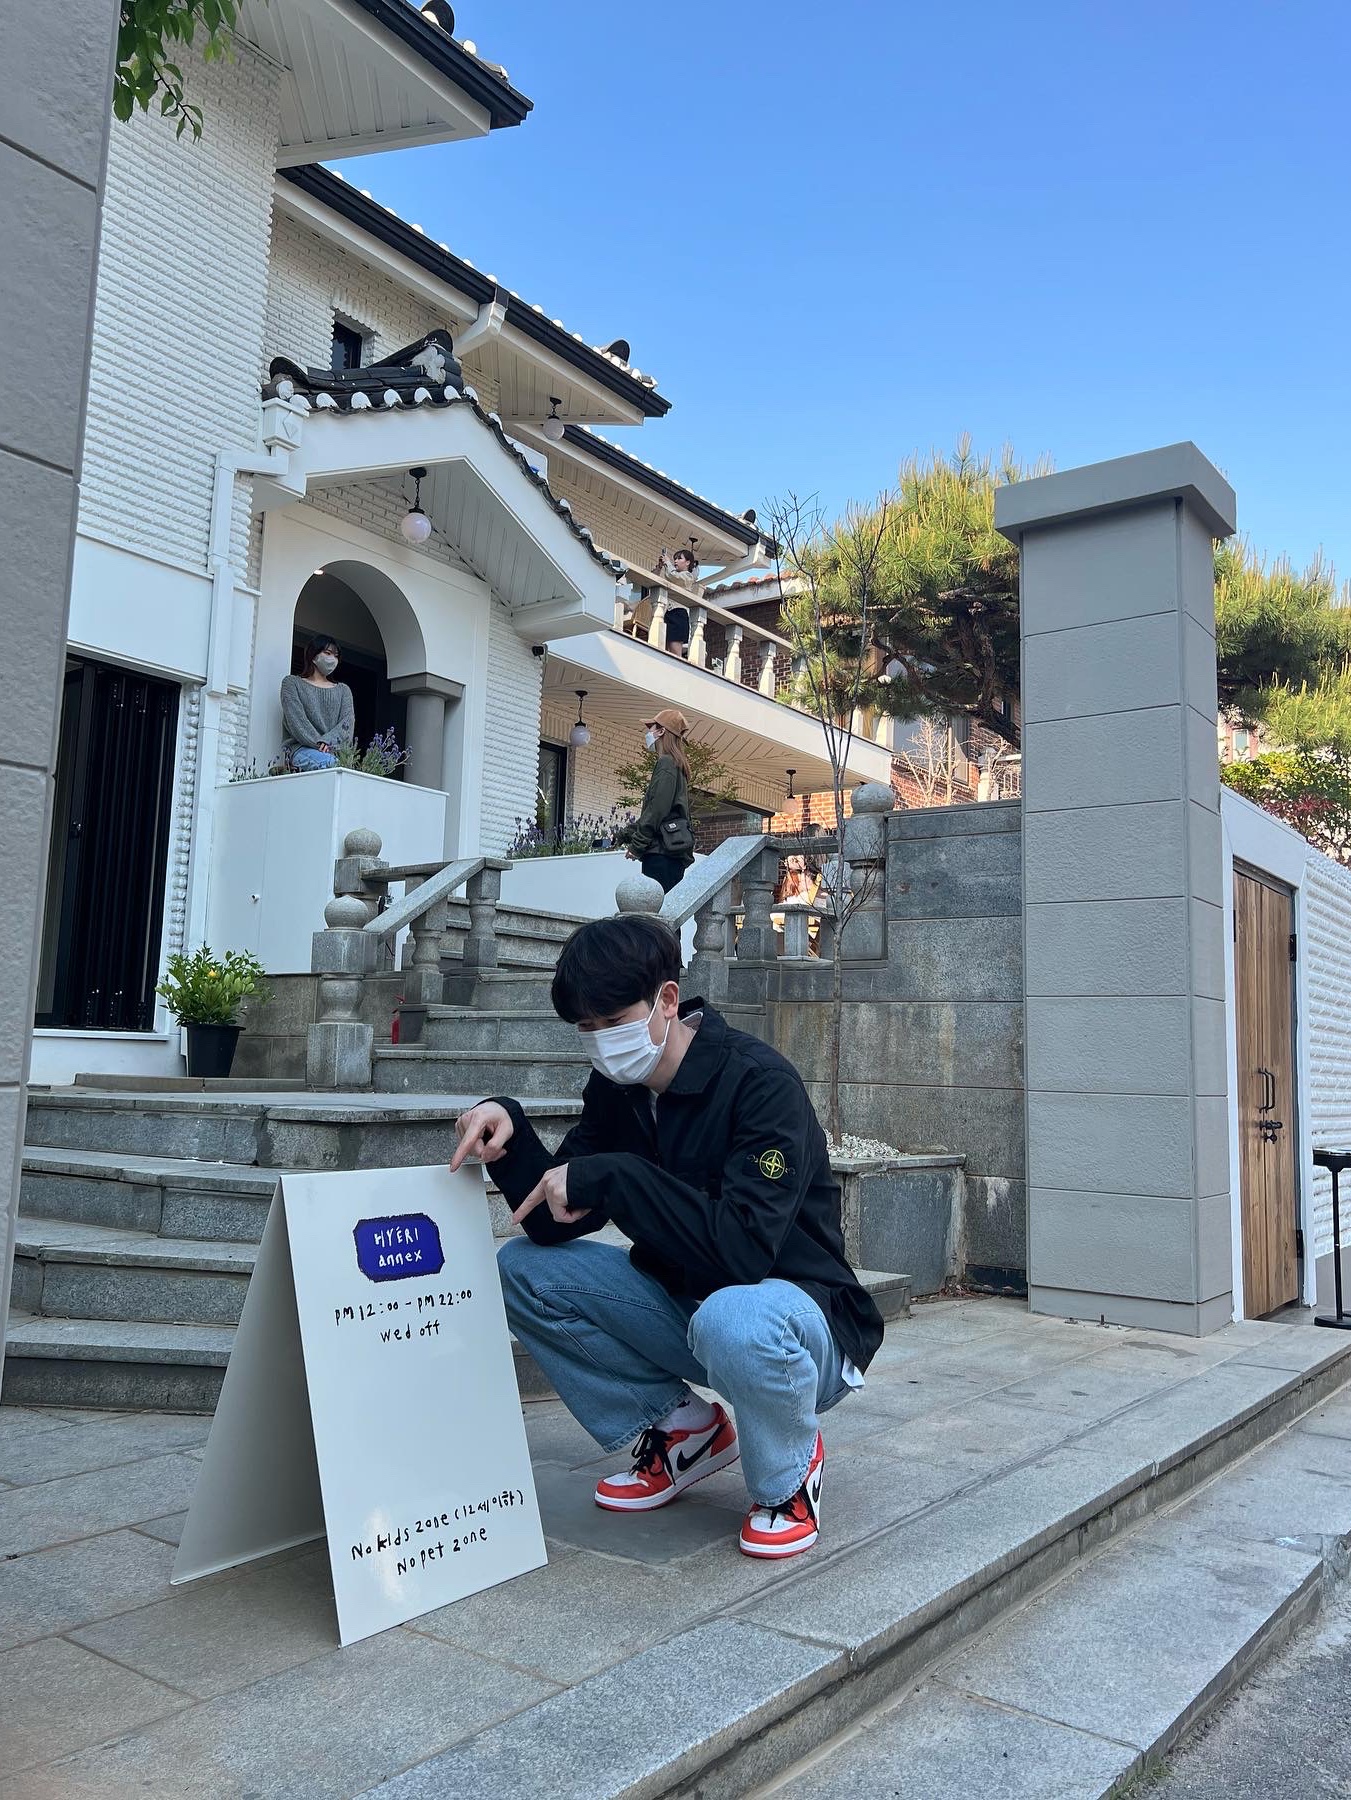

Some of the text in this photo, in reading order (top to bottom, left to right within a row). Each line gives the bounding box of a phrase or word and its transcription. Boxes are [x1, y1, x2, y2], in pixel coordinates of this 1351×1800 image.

[379, 1249, 423, 1268] annex
[419, 1319, 440, 1337] off
[351, 1542, 372, 1561] No
[397, 1557, 416, 1576] No
[420, 1541, 444, 1569] pet
